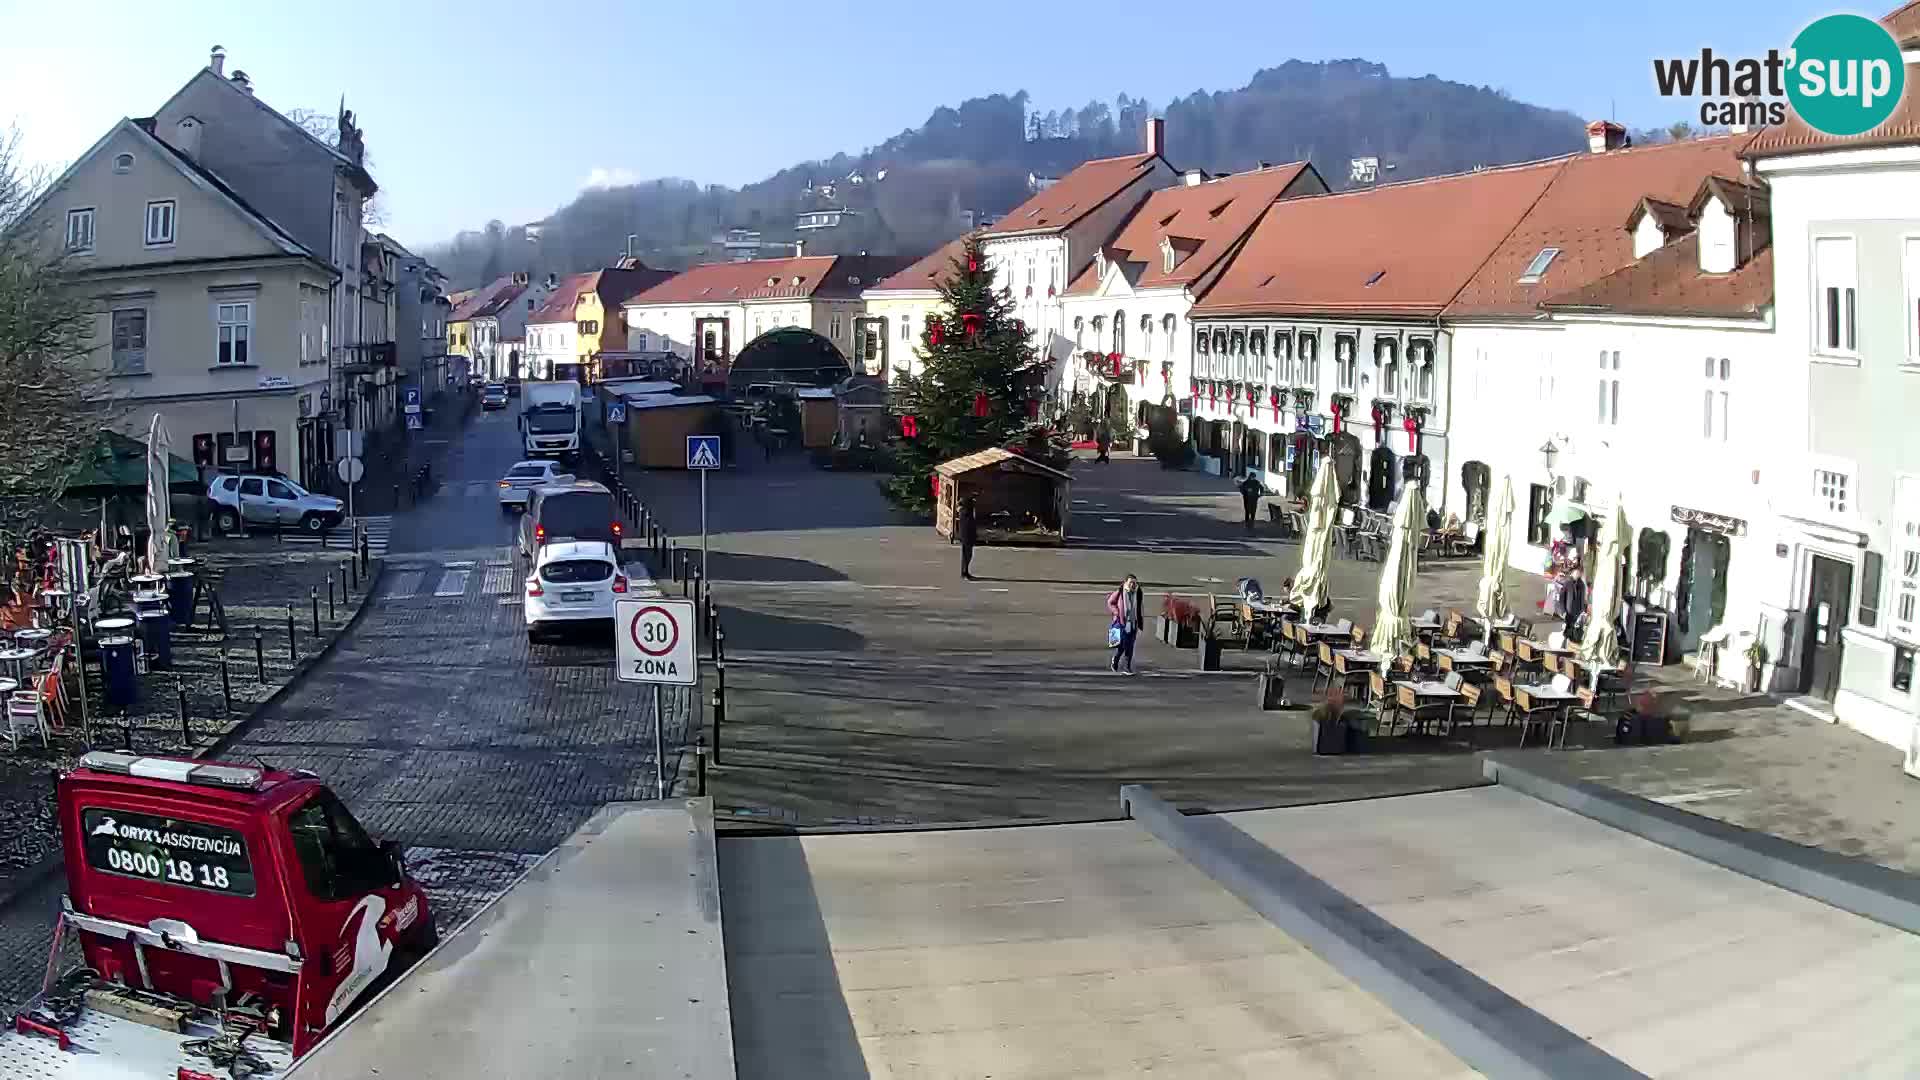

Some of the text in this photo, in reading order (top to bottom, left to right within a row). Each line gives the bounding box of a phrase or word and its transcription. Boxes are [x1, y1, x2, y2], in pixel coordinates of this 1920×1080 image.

[643, 622, 667, 642] 30
[633, 660, 677, 676] ZONA
[120, 824, 153, 843] ORYX
[107, 848, 229, 889] 0800 18 18
